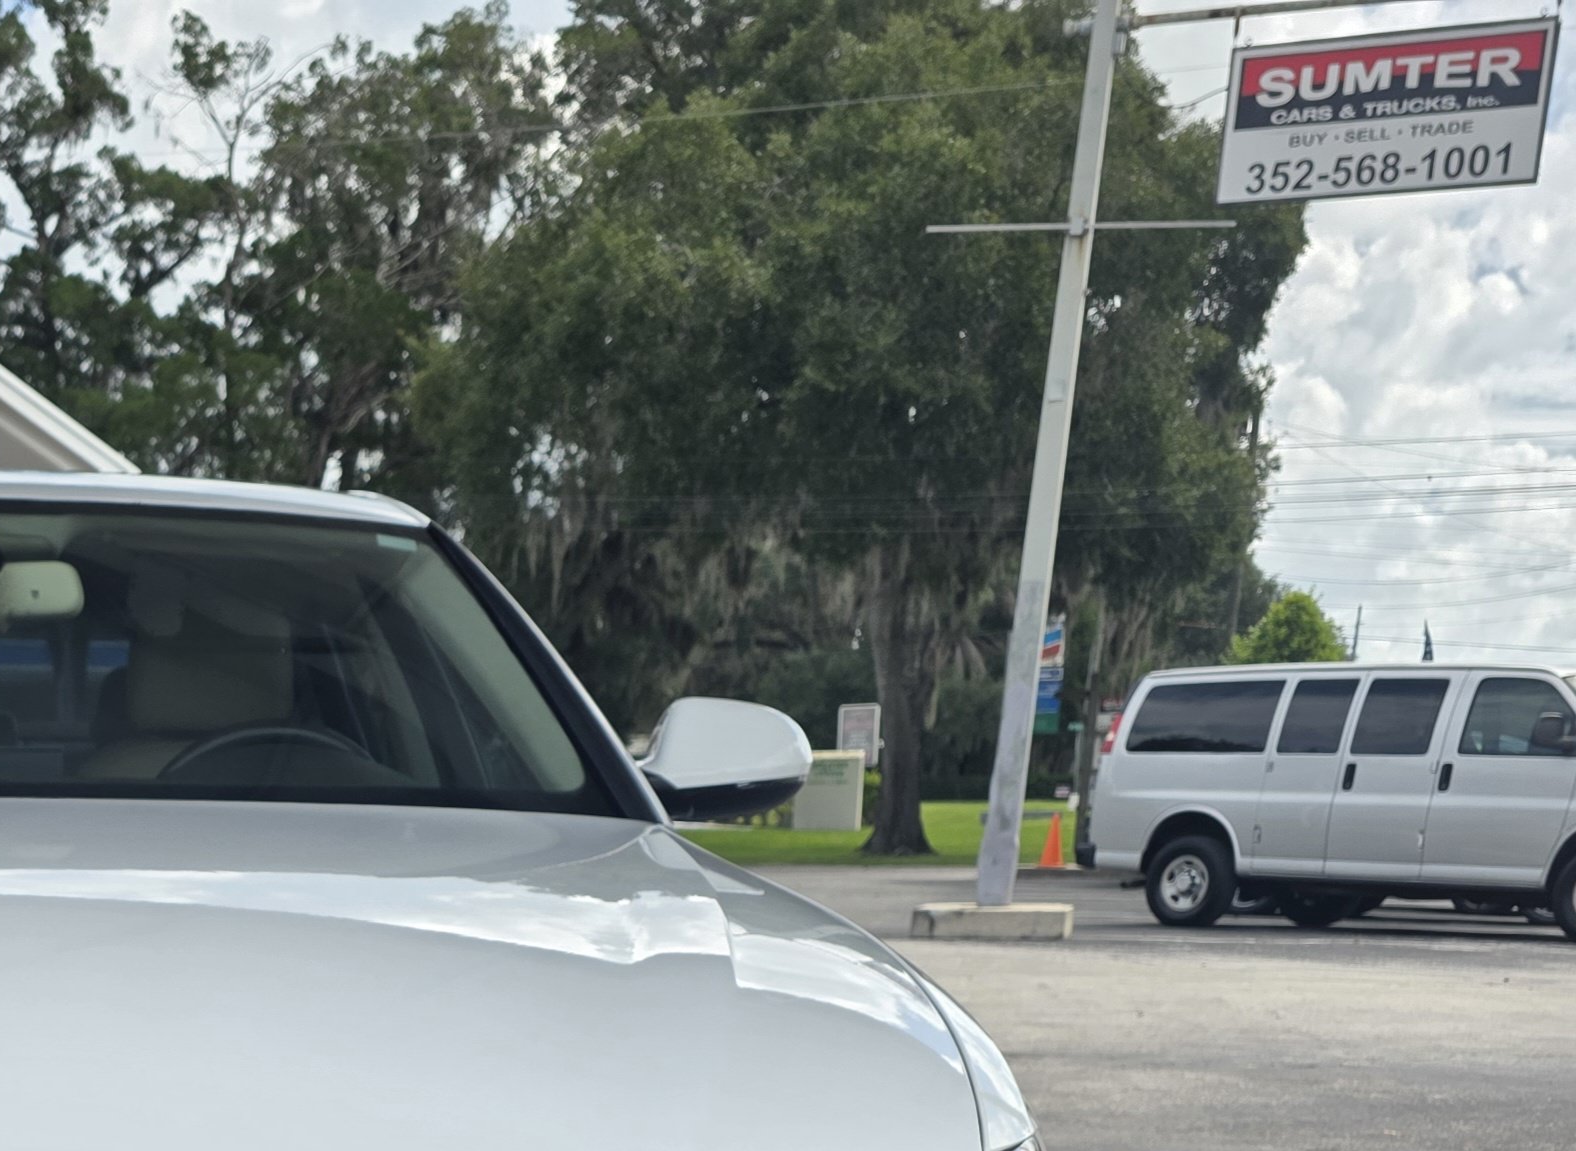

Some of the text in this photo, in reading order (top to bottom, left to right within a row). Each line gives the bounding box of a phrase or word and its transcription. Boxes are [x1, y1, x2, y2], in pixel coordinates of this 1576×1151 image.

[1254, 47, 1522, 108] SUMTER
[1270, 105, 1332, 125] CARS
[1338, 104, 1357, 119] &
[1466, 93, 1500, 108] Inc.
[1288, 120, 1474, 149] BUY SELL TRADE
[1245, 141, 1513, 195] 352-568-1001
